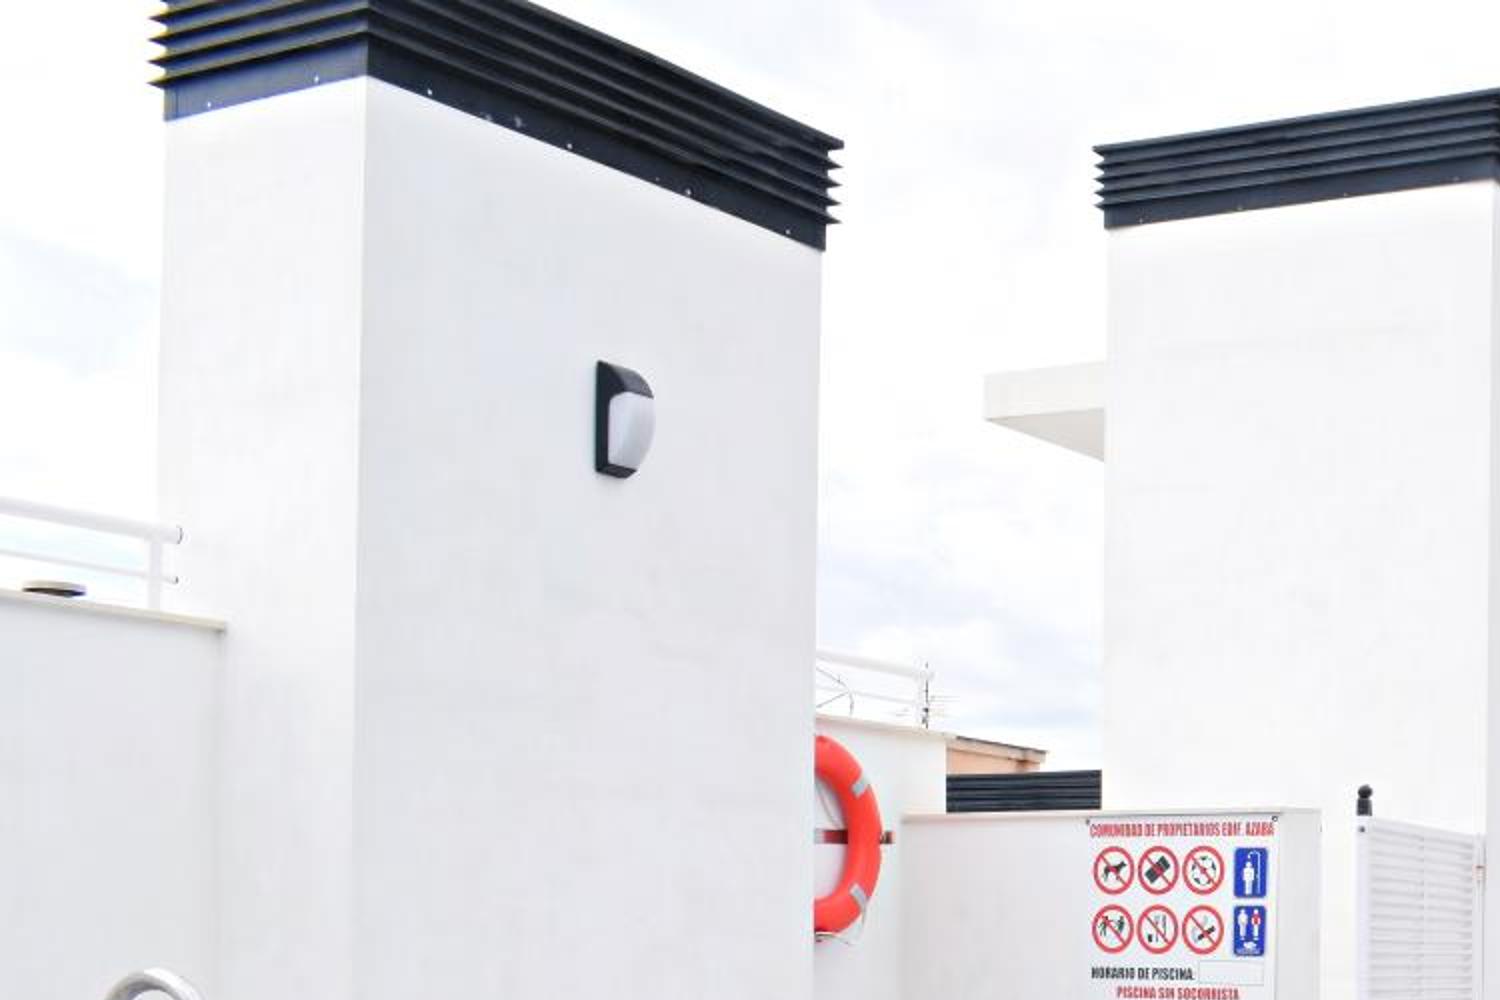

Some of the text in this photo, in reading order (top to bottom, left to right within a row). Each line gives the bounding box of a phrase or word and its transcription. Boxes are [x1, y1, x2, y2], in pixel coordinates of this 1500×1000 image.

[1091, 967, 1135, 979] HORARIO
[1138, 967, 1149, 979] DE
[1117, 986, 1240, 1000] PISCINA SIN SOCORRISTA
